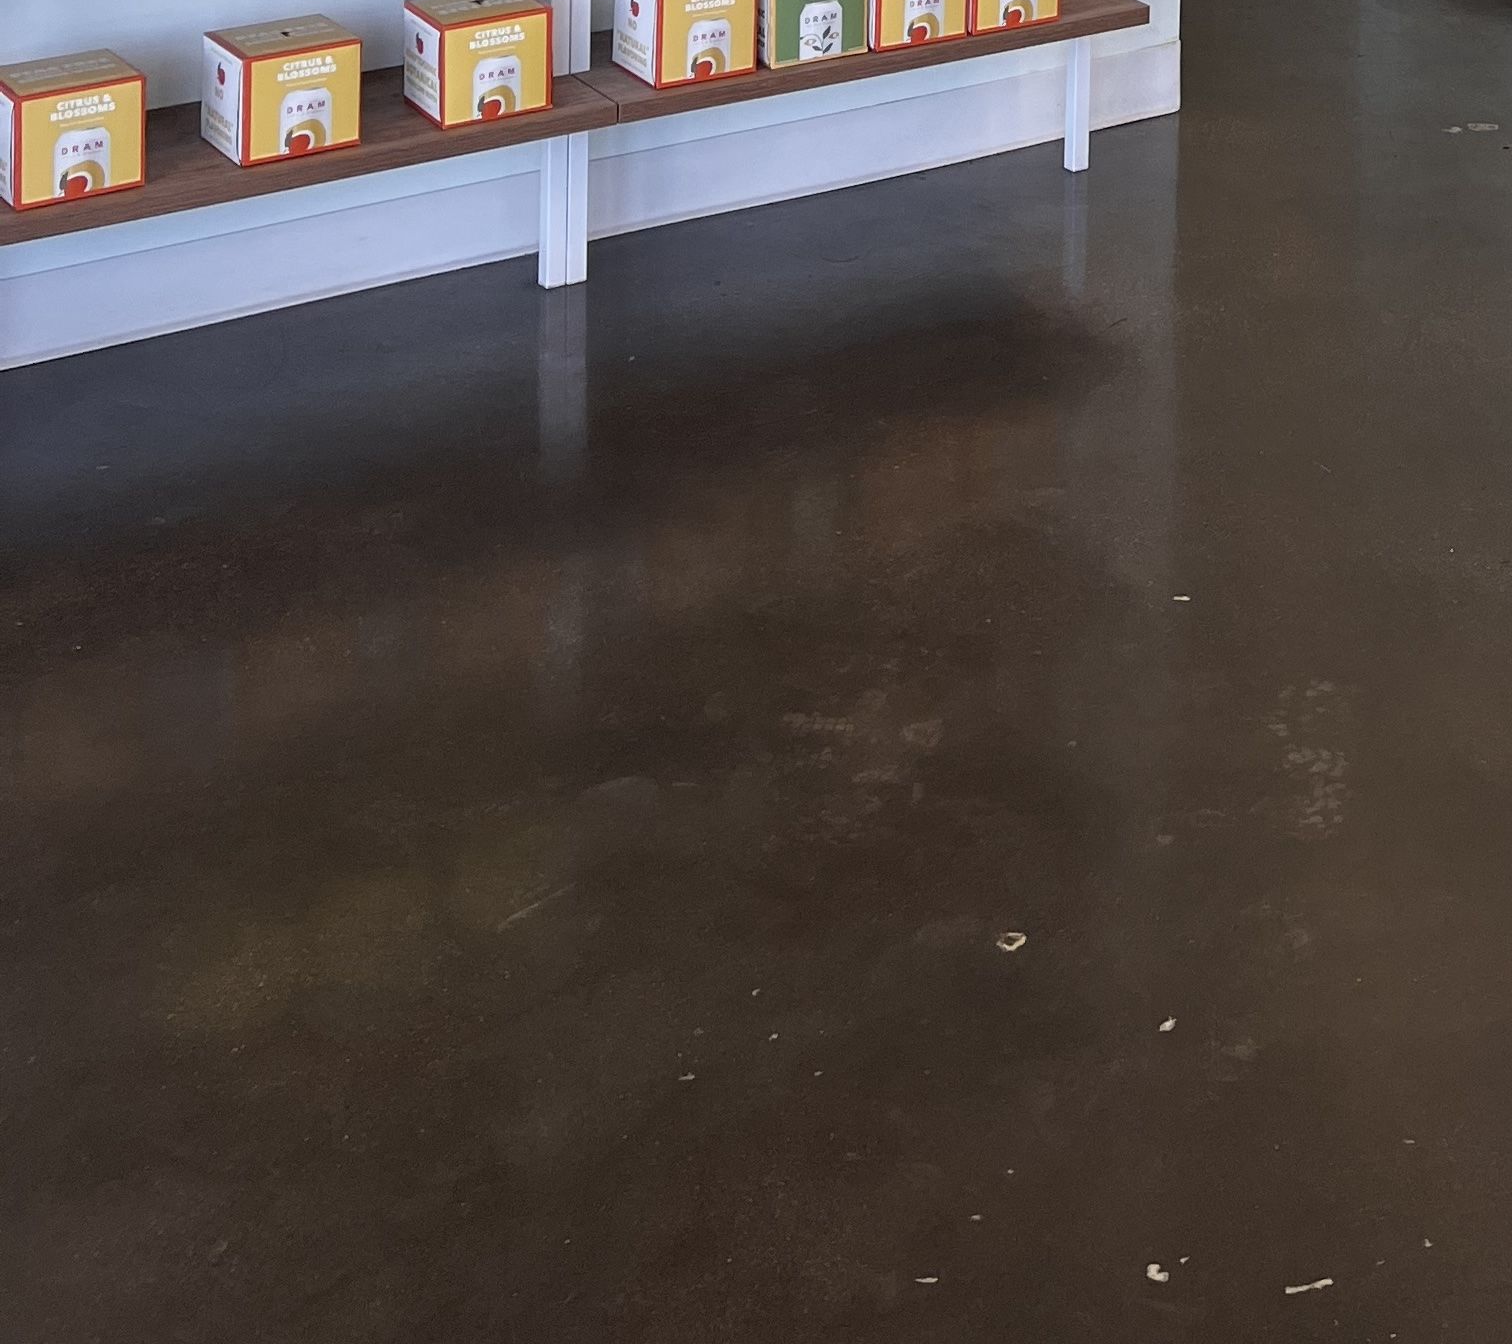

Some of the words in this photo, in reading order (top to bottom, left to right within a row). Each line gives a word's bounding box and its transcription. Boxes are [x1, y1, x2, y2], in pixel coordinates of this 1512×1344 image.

[475, 25, 511, 40] CITRUS
[692, 30, 726, 42] DRAM
[469, 32, 525, 49] BLOSSOMS
[283, 56, 322, 71] CITRUS
[276, 64, 337, 81] BLOSSOMS
[479, 67, 516, 80] DRAM
[50, 102, 116, 121] BLOSSOMS
[57, 97, 100, 111] CITRUS
[286, 100, 325, 114] DRAM
[61, 140, 104, 155] DRAM
